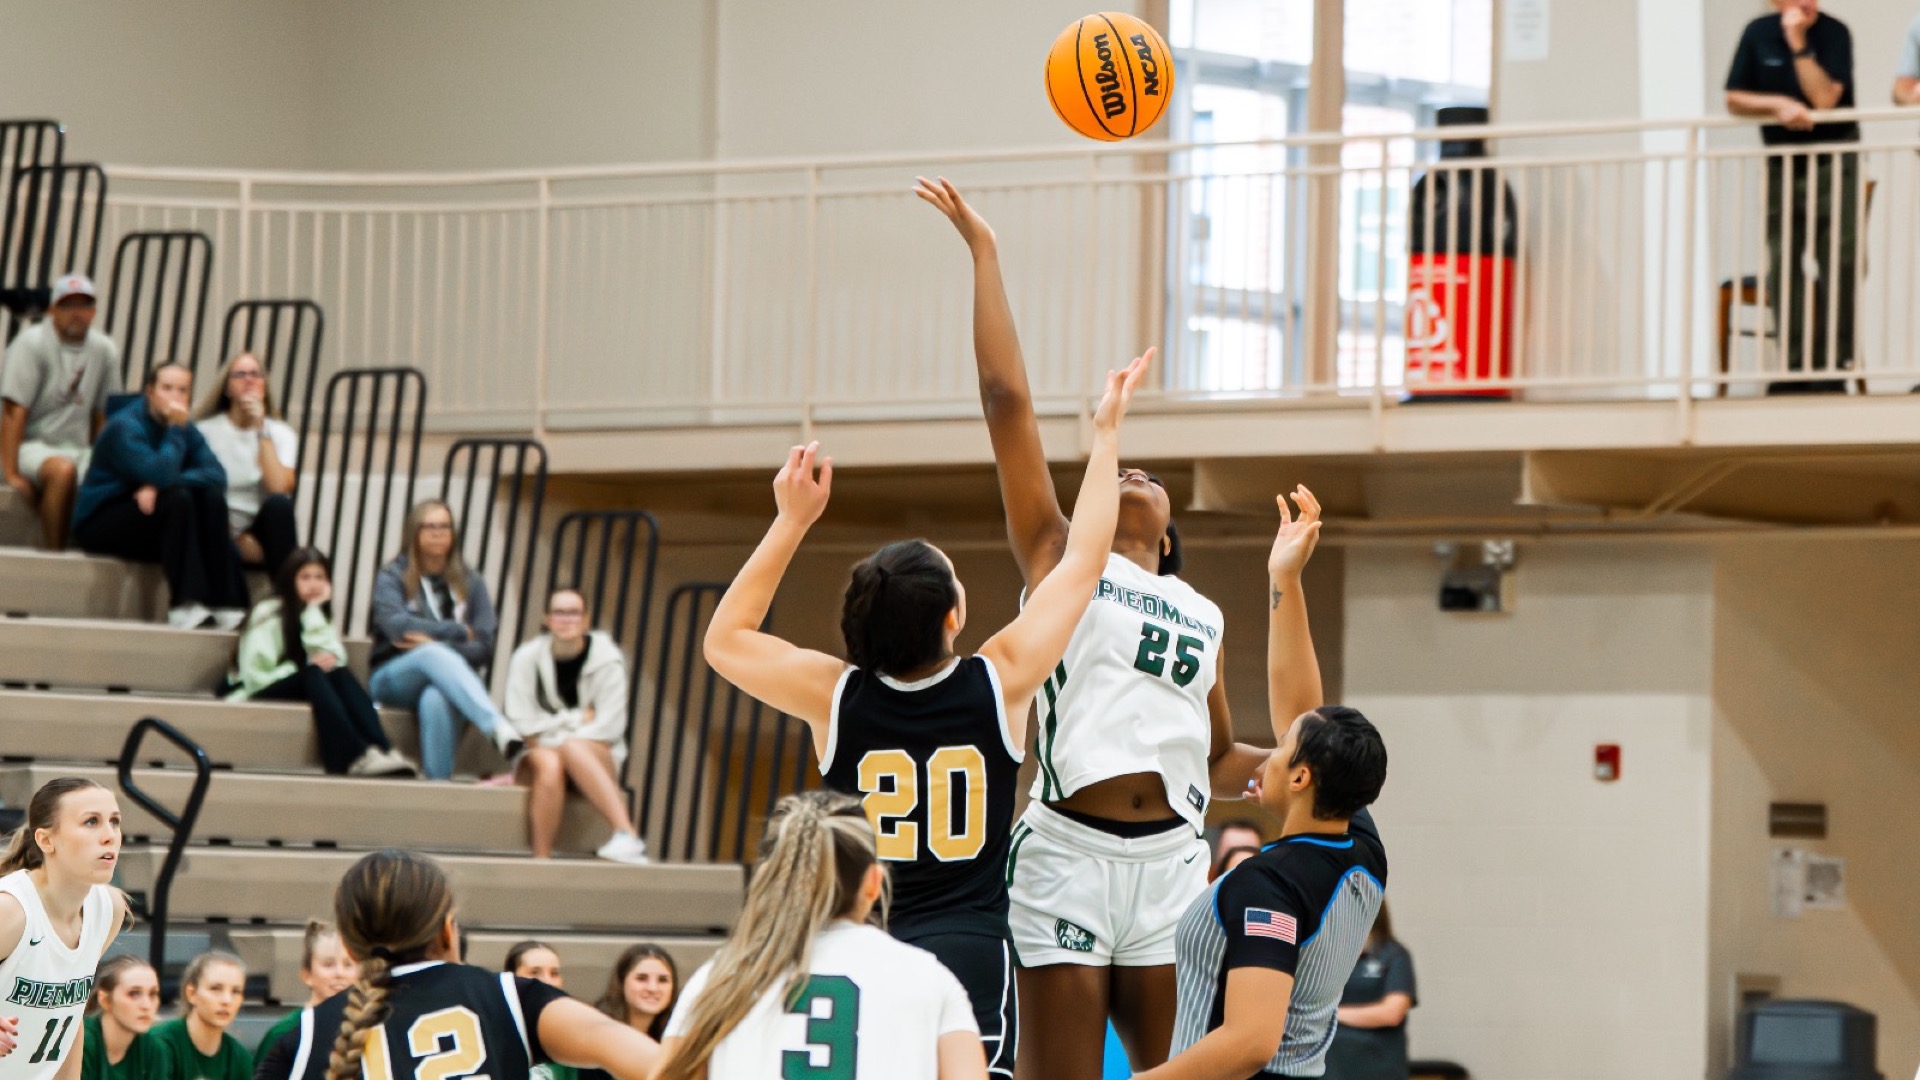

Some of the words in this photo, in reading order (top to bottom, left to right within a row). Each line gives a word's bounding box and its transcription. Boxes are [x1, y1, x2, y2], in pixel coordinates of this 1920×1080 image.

[1093, 32, 1127, 119] Wilson
[1130, 33, 1159, 96] NCAA
[1133, 621, 1205, 689] 25
[857, 744, 987, 862] 20
[28, 1015, 74, 1064] 11
[781, 973, 861, 1080] 3
